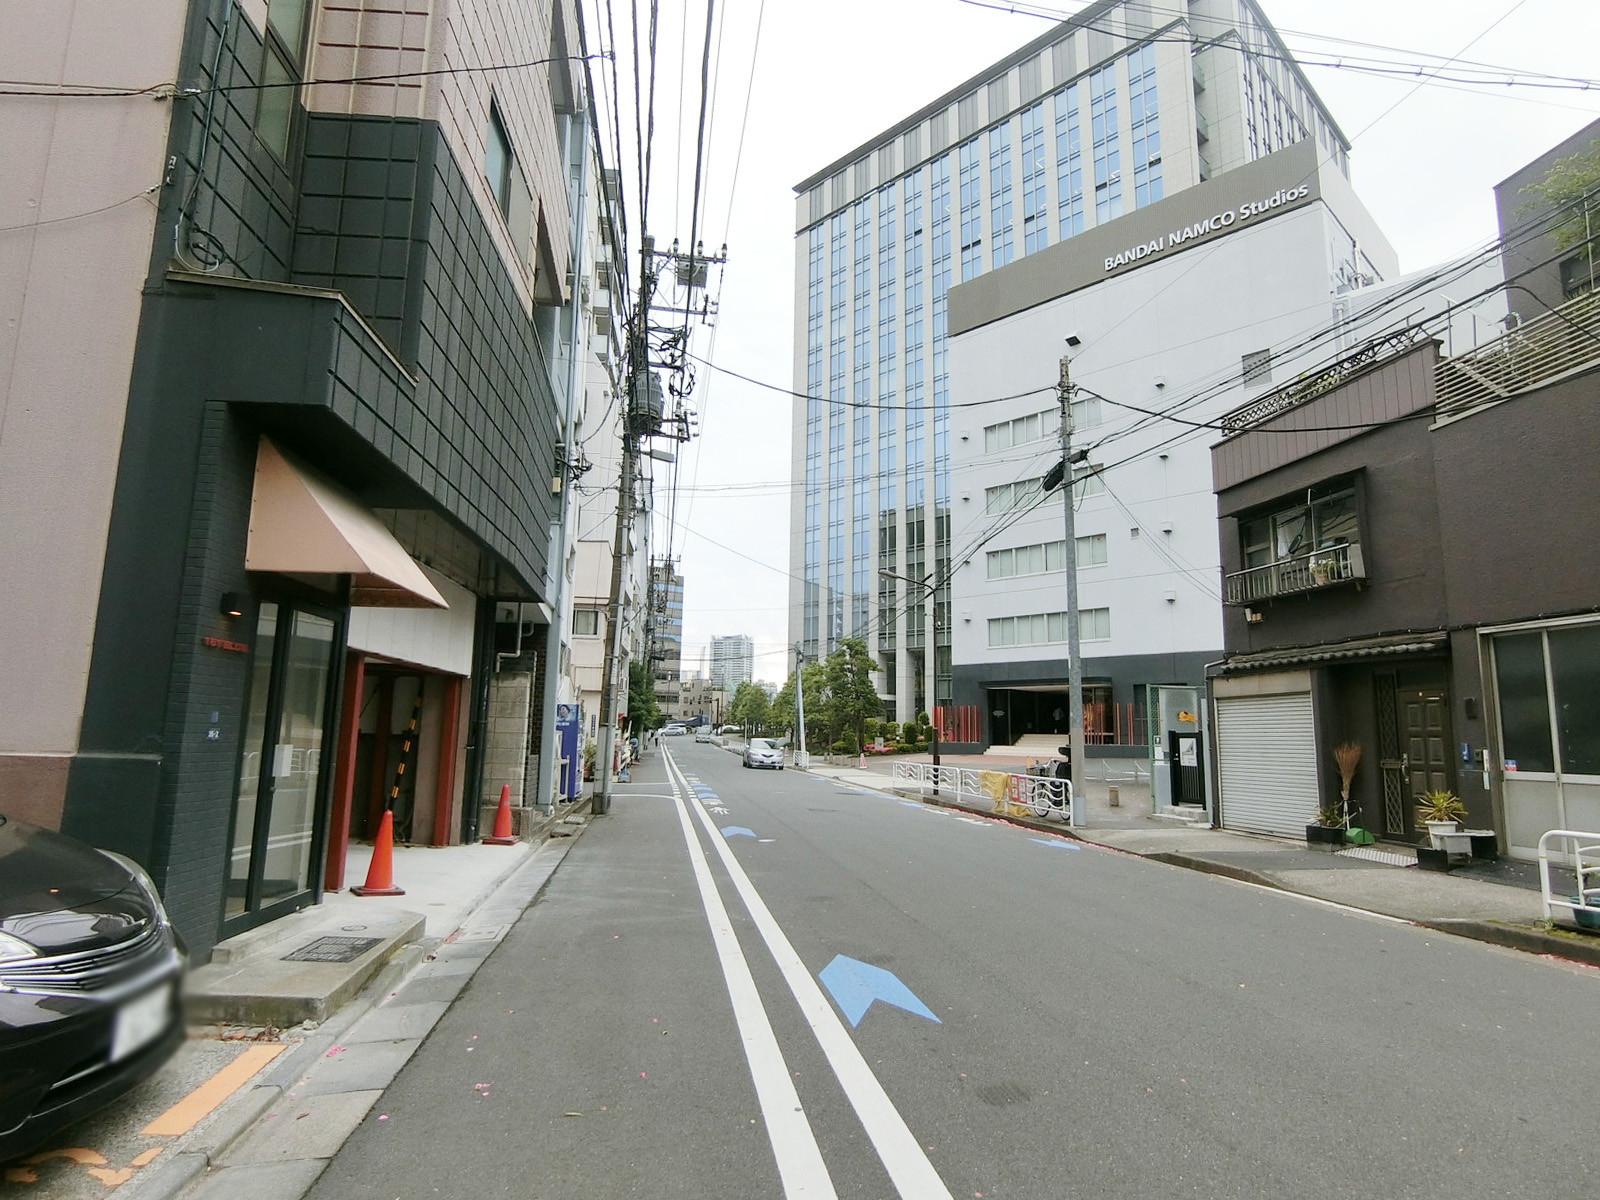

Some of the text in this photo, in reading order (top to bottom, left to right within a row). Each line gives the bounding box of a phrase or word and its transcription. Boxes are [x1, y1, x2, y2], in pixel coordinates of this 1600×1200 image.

[1104, 184, 1309, 272] BANDAI NAMCO Studios
